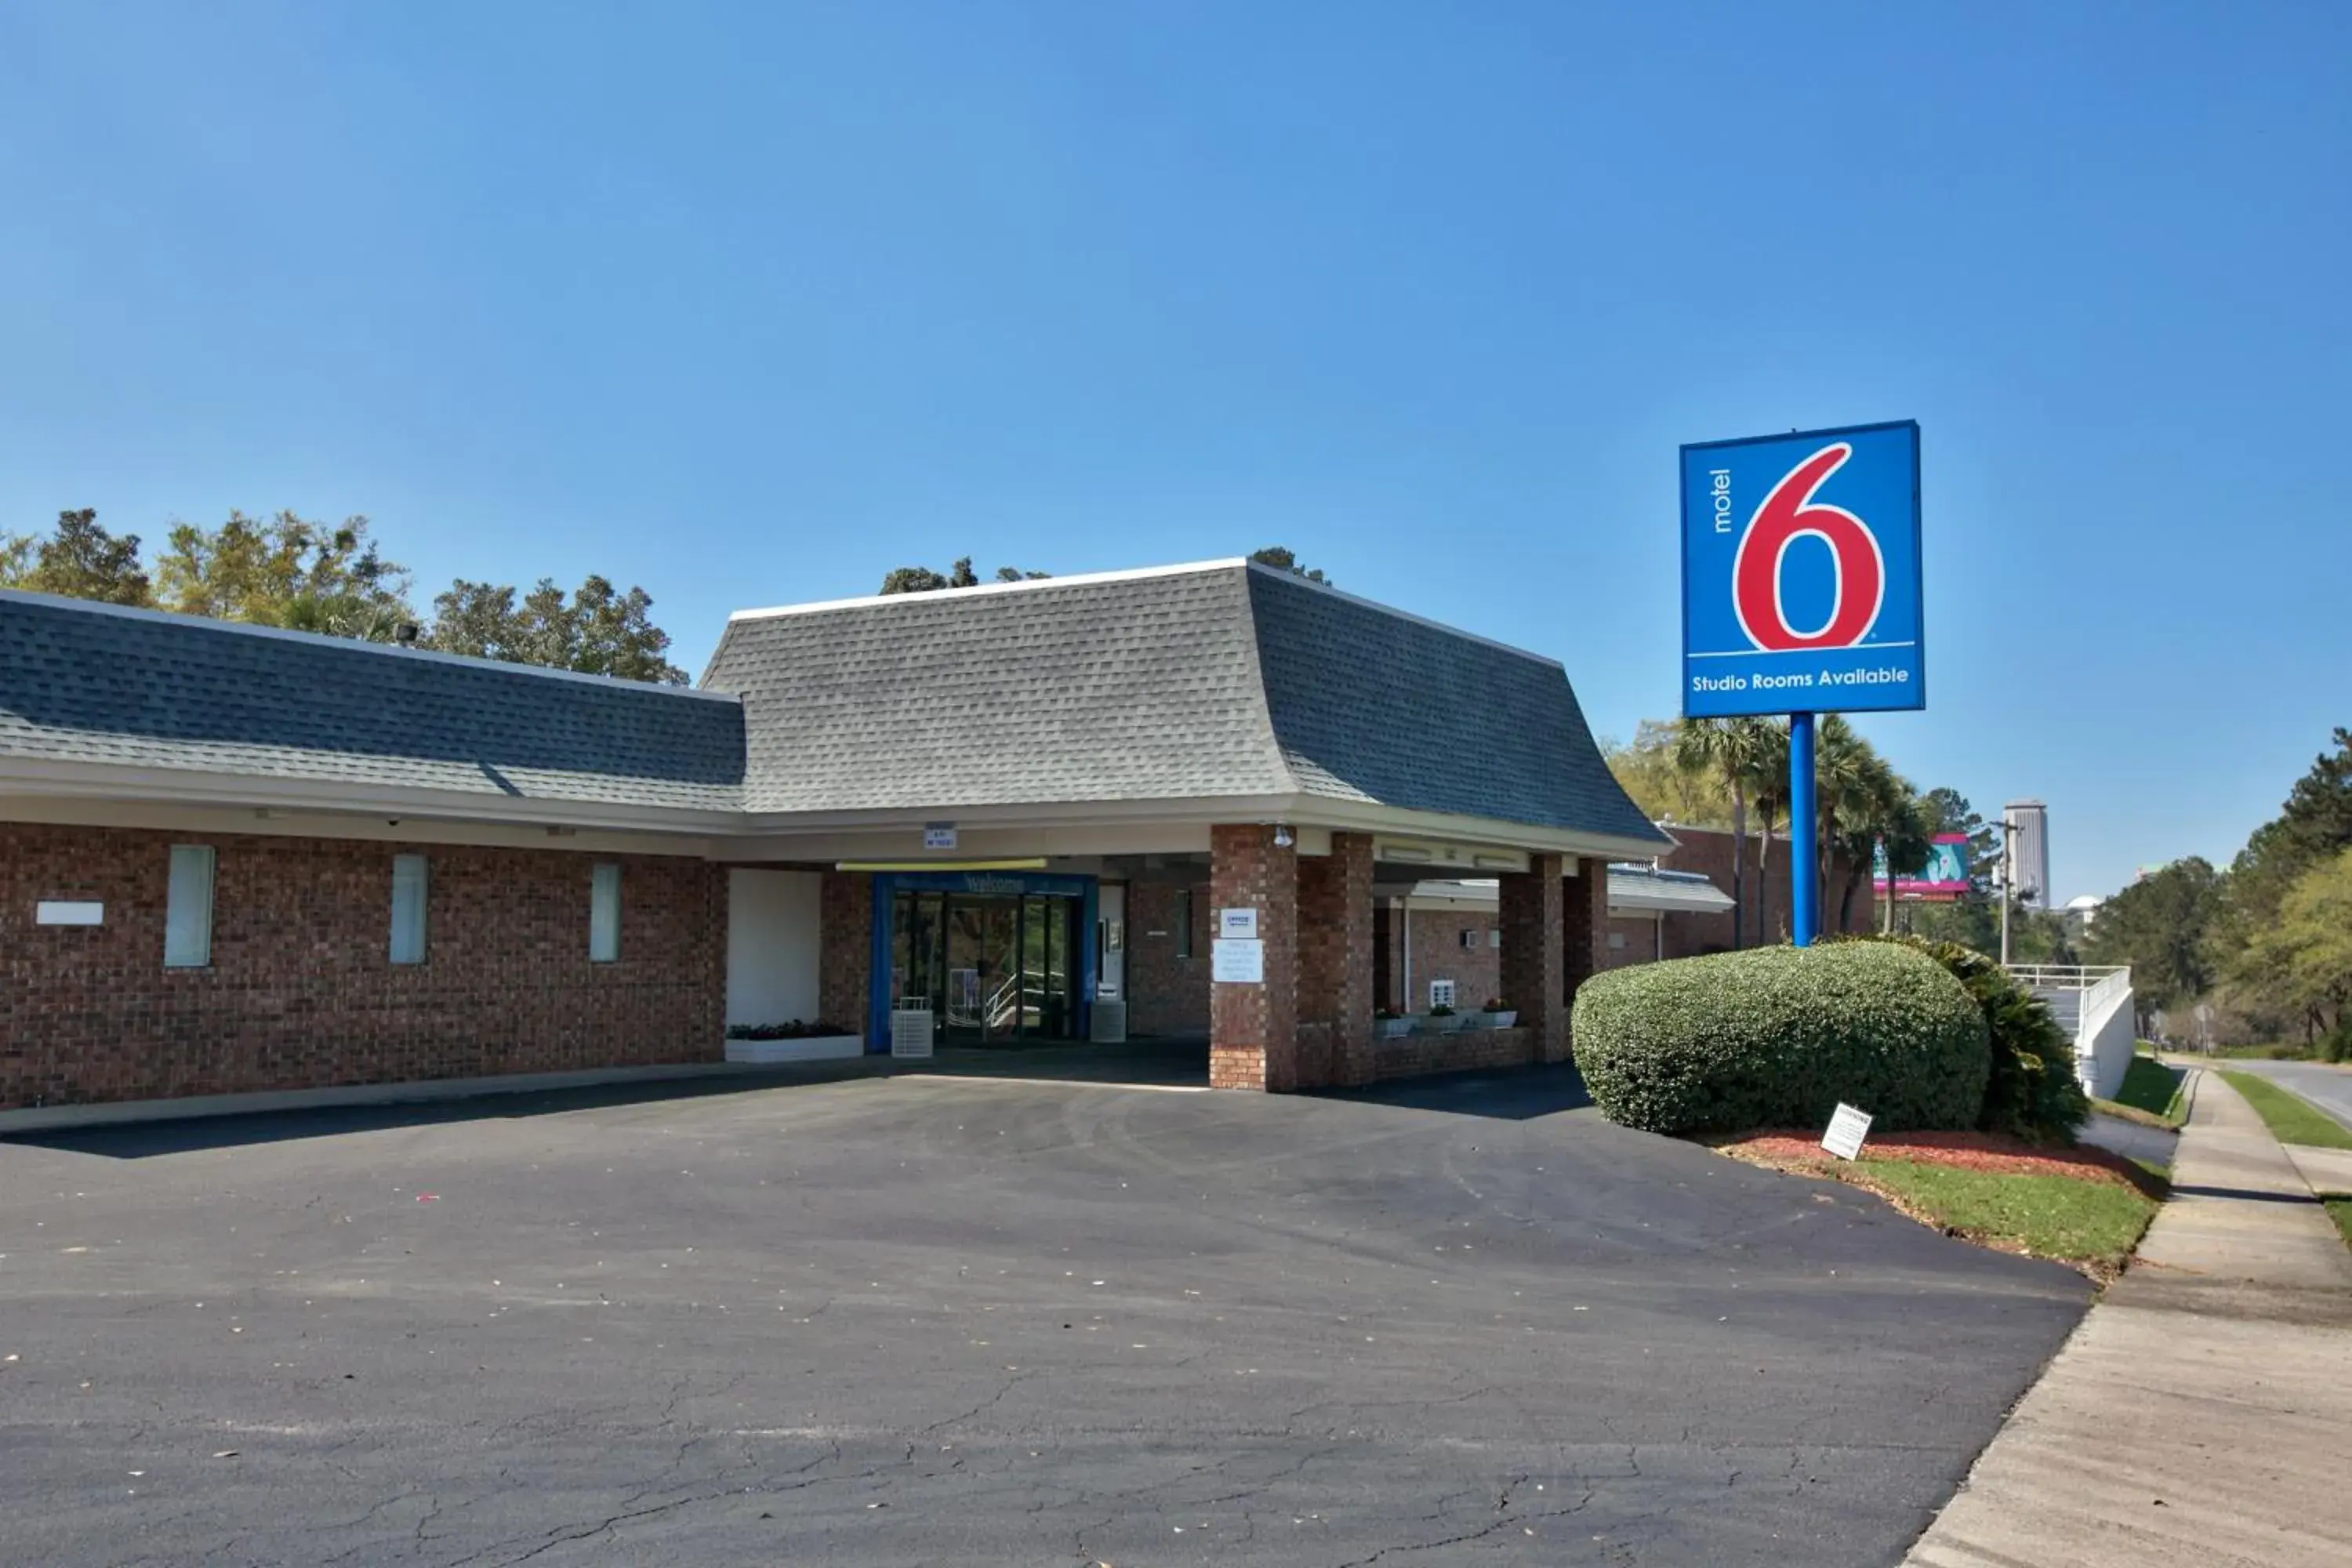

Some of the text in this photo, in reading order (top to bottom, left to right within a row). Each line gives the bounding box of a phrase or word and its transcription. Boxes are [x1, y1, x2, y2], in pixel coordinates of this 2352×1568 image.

[1709, 469, 1731, 533] motel
[1732, 441, 1886, 652] 6
[1693, 666, 1909, 691] Studio Rooms Available
